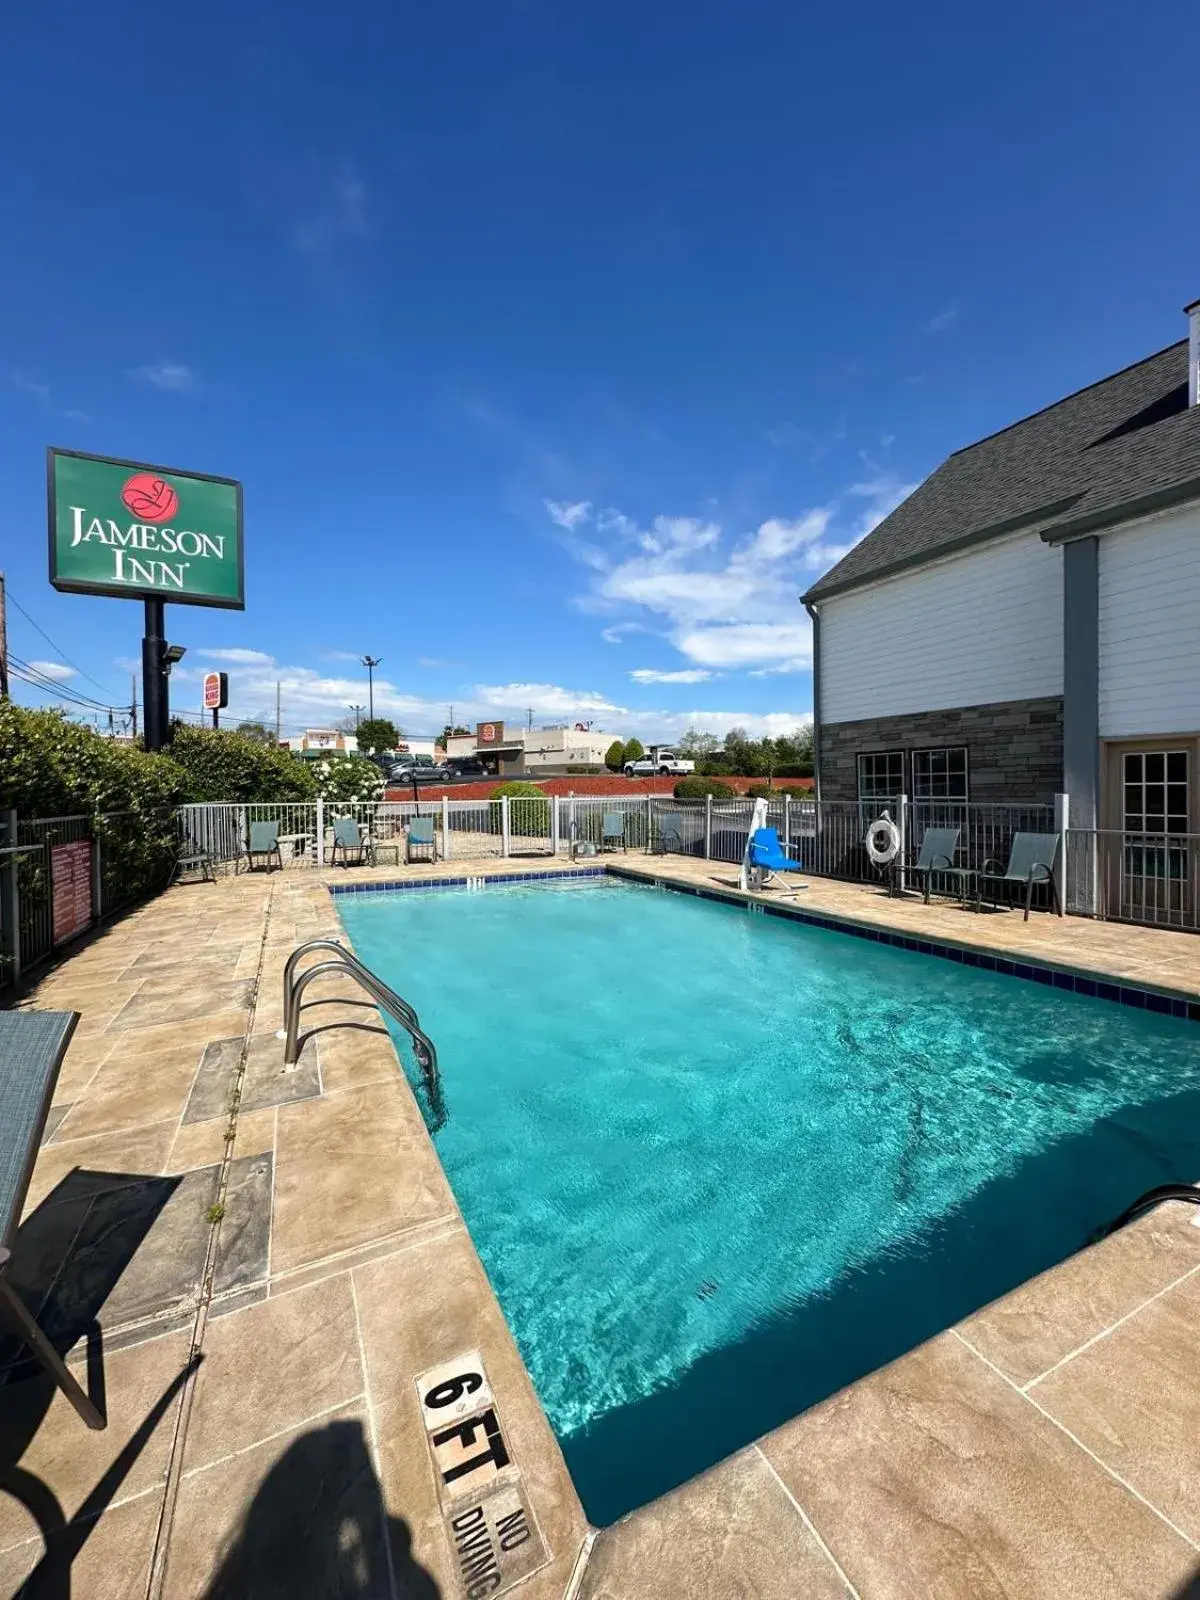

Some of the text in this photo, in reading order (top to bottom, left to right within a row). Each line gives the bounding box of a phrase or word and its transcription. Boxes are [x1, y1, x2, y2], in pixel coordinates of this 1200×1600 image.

[69, 506, 225, 559] JAMESON
[111, 548, 186, 588] INN
[424, 1372, 511, 1485] 6 FT
[451, 1505, 502, 1600] DIVING
[495, 1508, 531, 1552] NO
